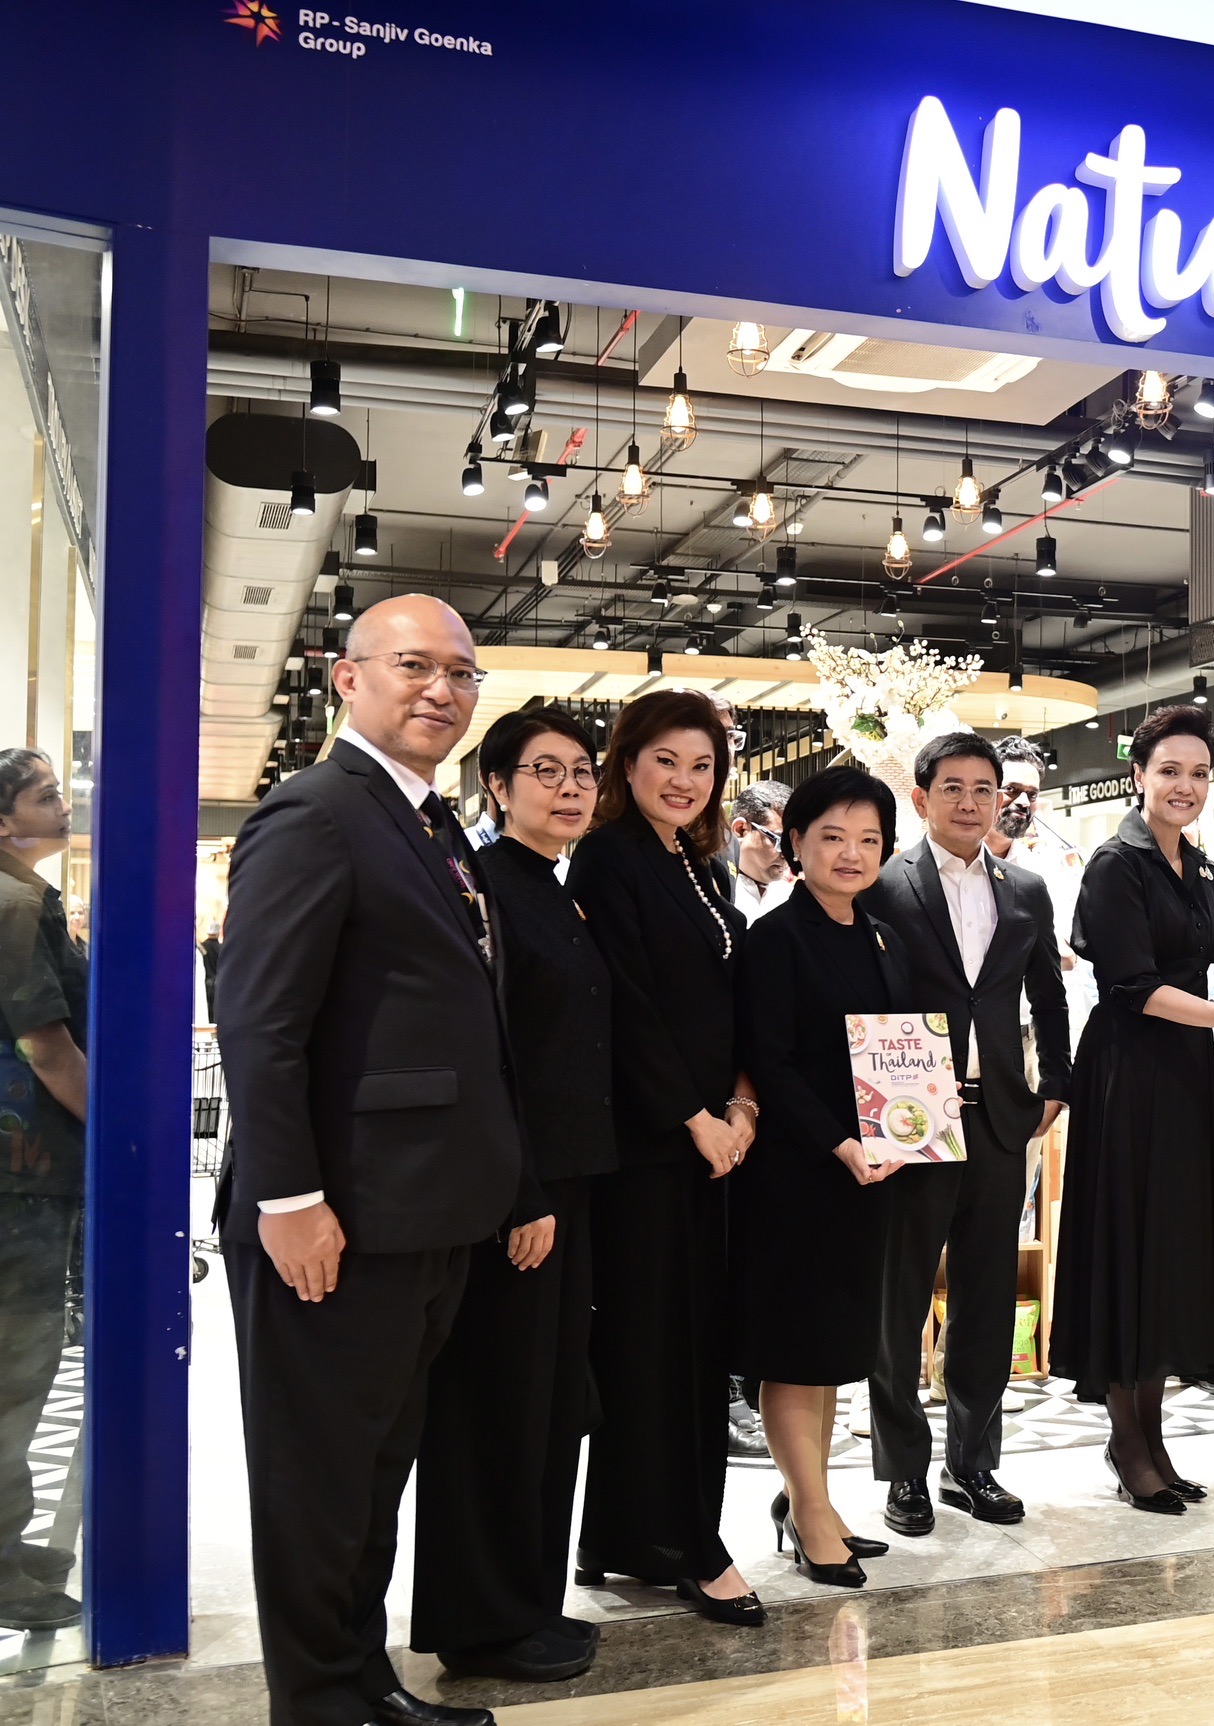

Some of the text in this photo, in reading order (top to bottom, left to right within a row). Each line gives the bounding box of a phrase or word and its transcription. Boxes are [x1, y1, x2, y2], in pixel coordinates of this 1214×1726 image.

[298, 32, 367, 59] Group
[413, 28, 494, 56] Goenka
[1090, 780, 1119, 800] GOOD
[878, 1038, 923, 1051] TASTE
[867, 1050, 937, 1073] Thailand
